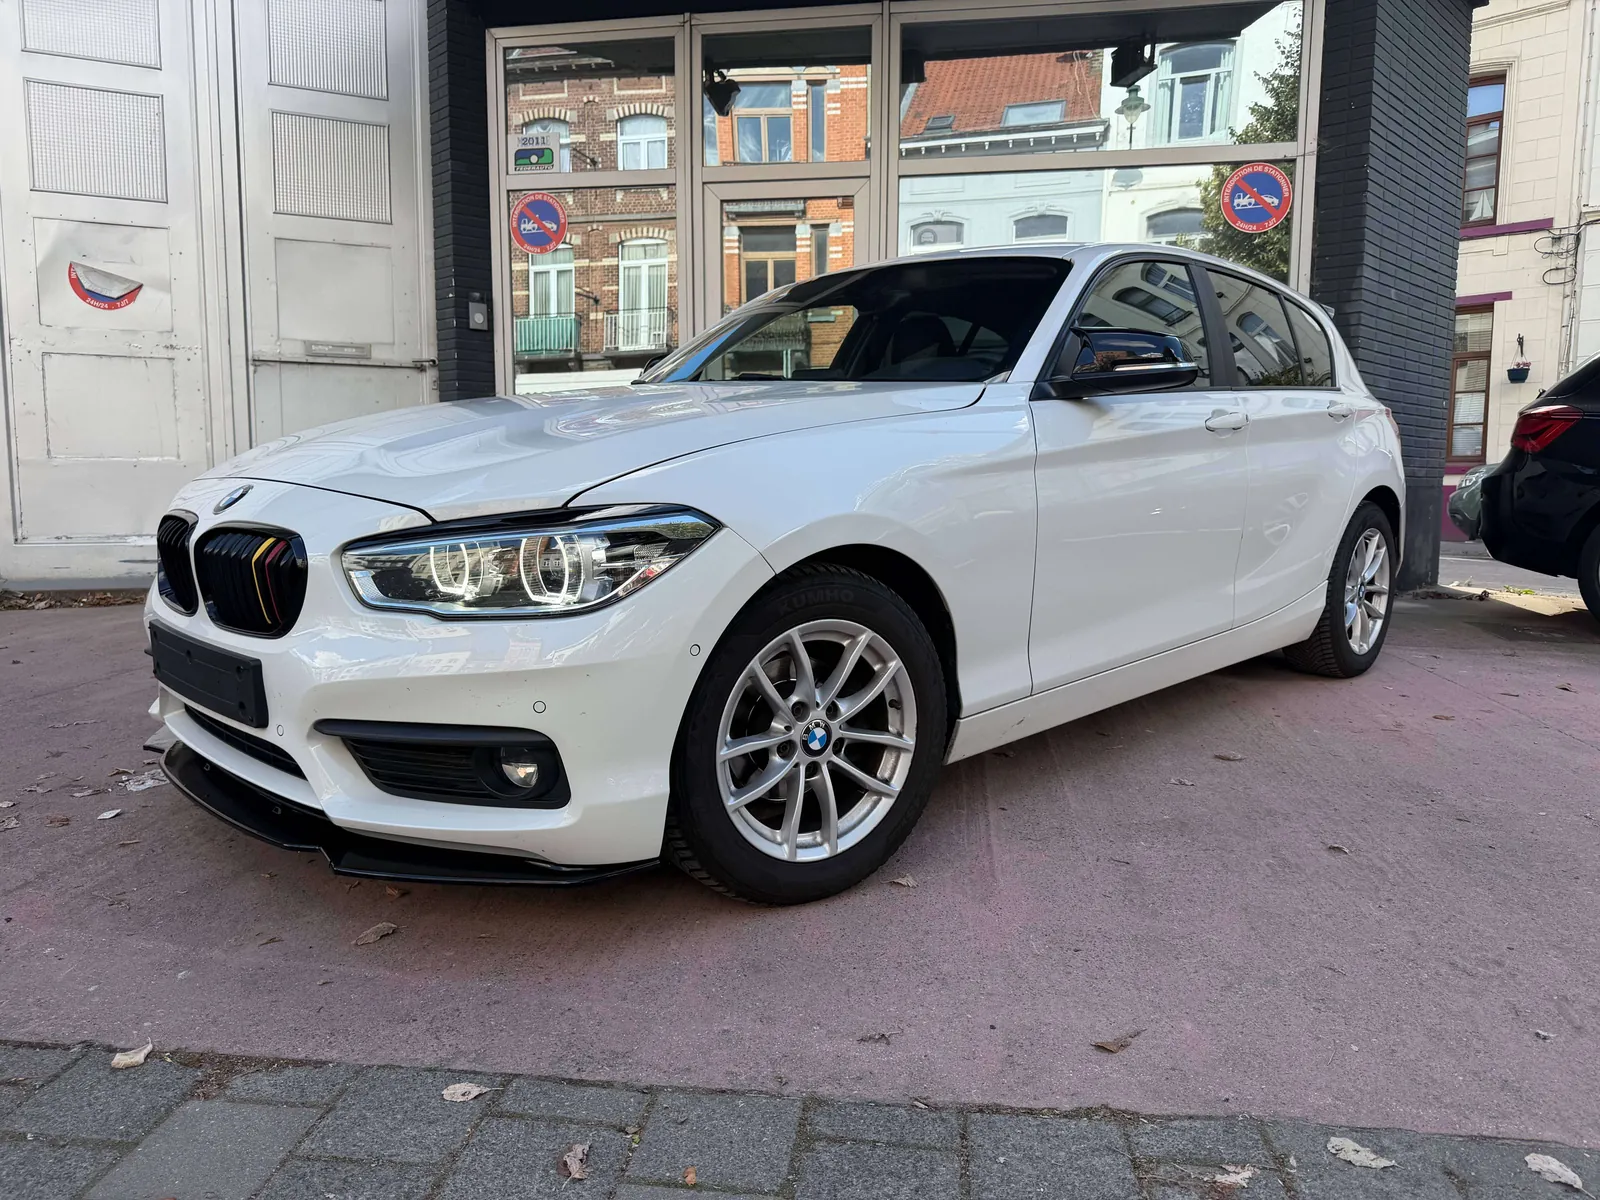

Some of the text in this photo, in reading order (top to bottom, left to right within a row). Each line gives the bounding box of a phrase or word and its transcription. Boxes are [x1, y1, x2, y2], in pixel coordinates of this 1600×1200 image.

[521, 136, 546, 146] 2011
[1223, 166, 1253, 203] INTERDICTION
[1263, 166, 1290, 197] STATIONNER
[1235, 220, 1257, 231] 24H/24
[86, 297, 109, 309] 24H/24
[802, 721, 825, 741] BMW
